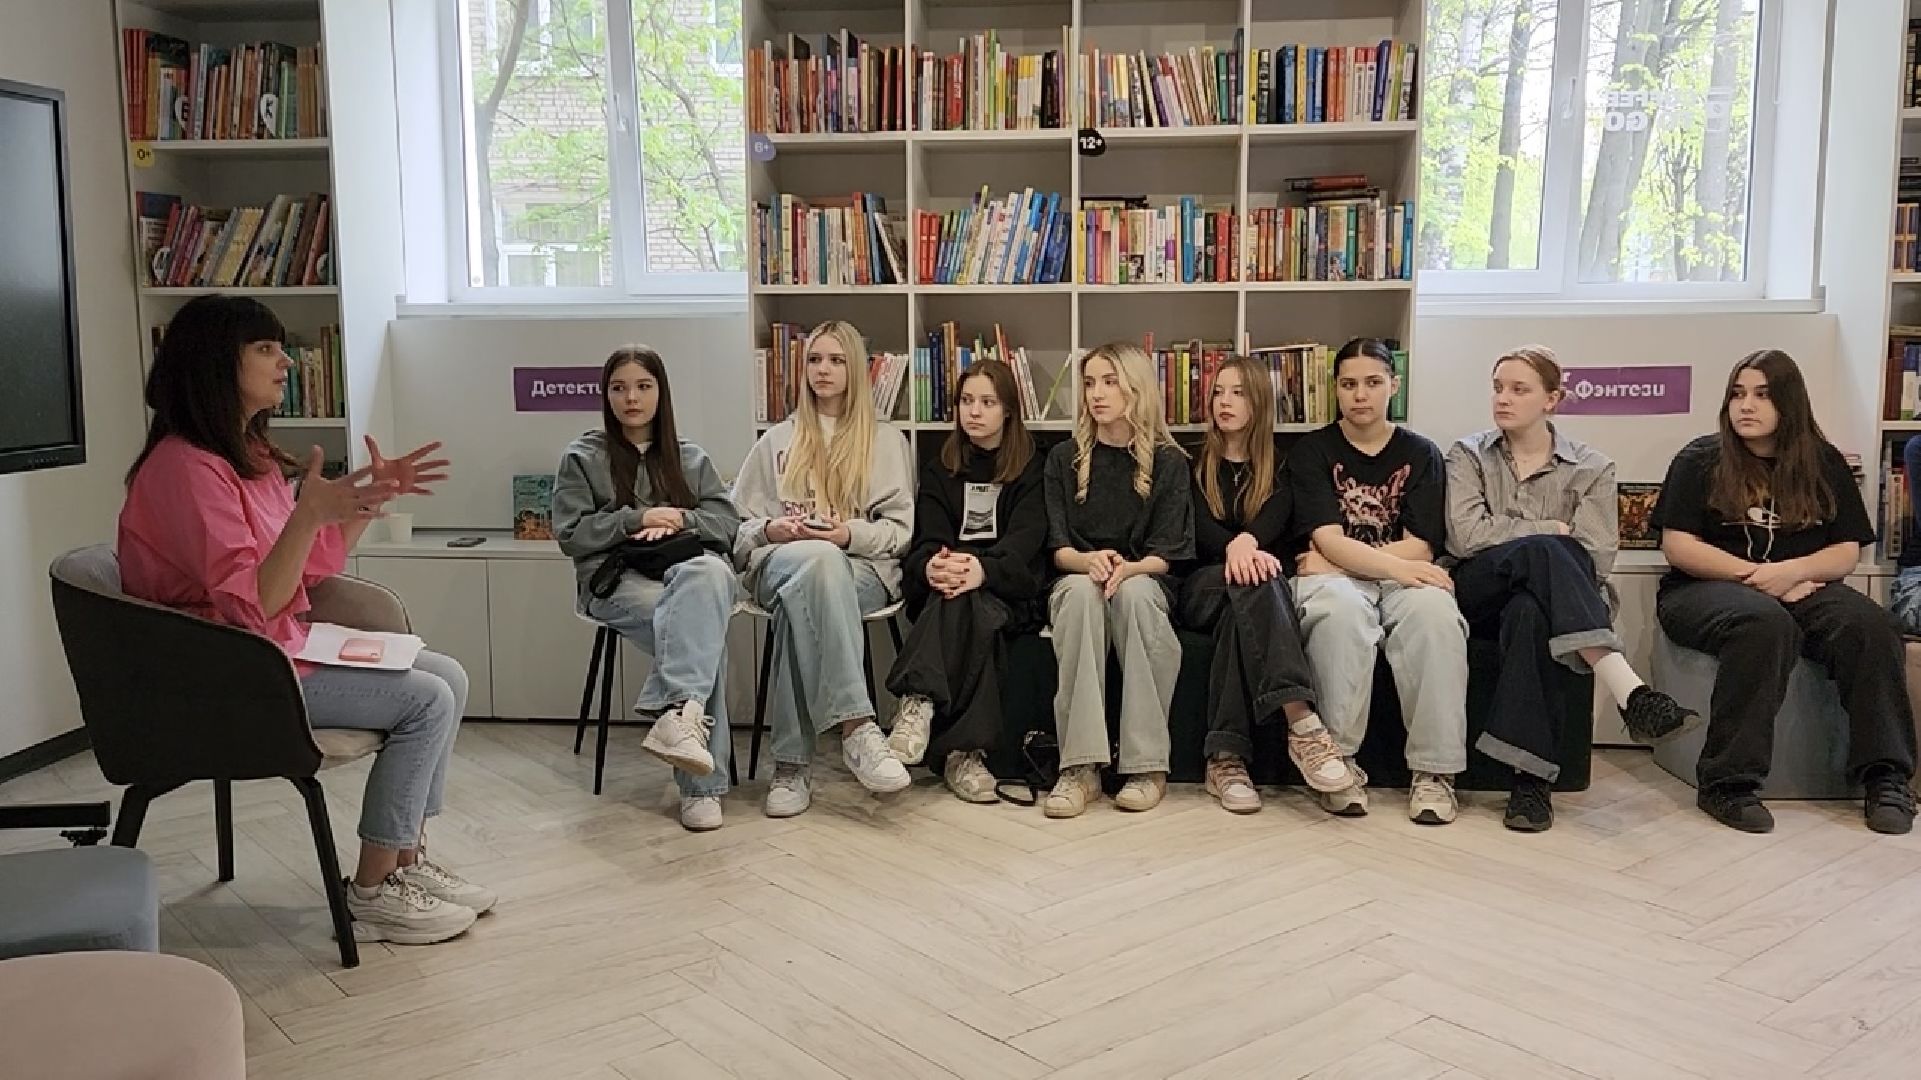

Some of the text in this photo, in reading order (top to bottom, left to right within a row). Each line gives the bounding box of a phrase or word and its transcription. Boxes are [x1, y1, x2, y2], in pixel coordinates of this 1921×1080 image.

[754, 141, 769, 153] 6+
[1079, 136, 1103, 149] 12+
[1575, 379, 1666, 400] Фэнтези
